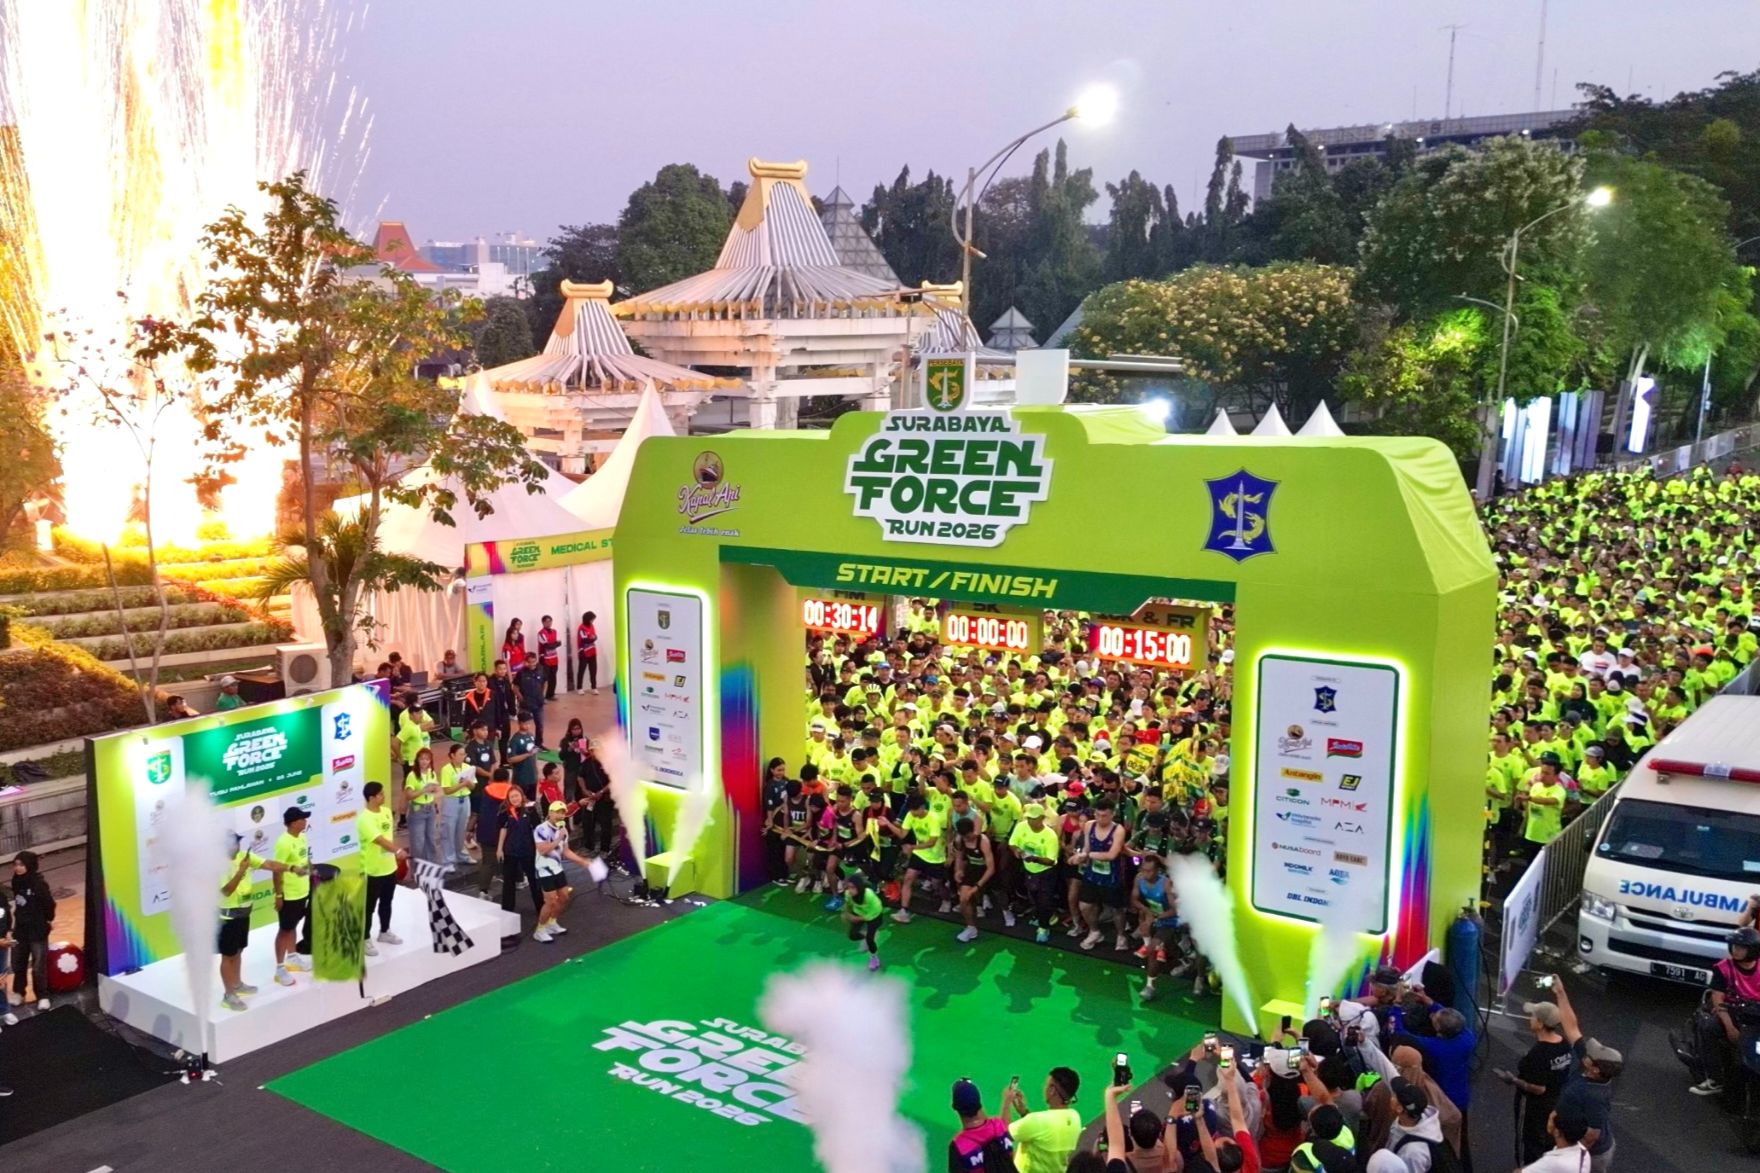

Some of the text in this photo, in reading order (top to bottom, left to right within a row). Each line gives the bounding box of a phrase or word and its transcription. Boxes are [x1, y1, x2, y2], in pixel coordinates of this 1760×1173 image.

[885, 416, 1011, 432] SURABAYA
[852, 438, 1043, 477] GREEN
[850, 475, 1041, 517] FORCE
[884, 519, 1000, 540] RUN 2026
[551, 541, 598, 555] MEDICAL
[804, 600, 878, 633] 00:30:14
[1168, 613, 1195, 628] FR
[948, 615, 1028, 649] 00:00:00
[1100, 626, 1191, 664] 00:15:00
[222, 744, 288, 771] FORCE
[223, 731, 288, 759] GREEN
[1276, 796, 1310, 805] CITICON
[700, 1017, 808, 1055] SURAB
[608, 1062, 773, 1126] RUN 2026
